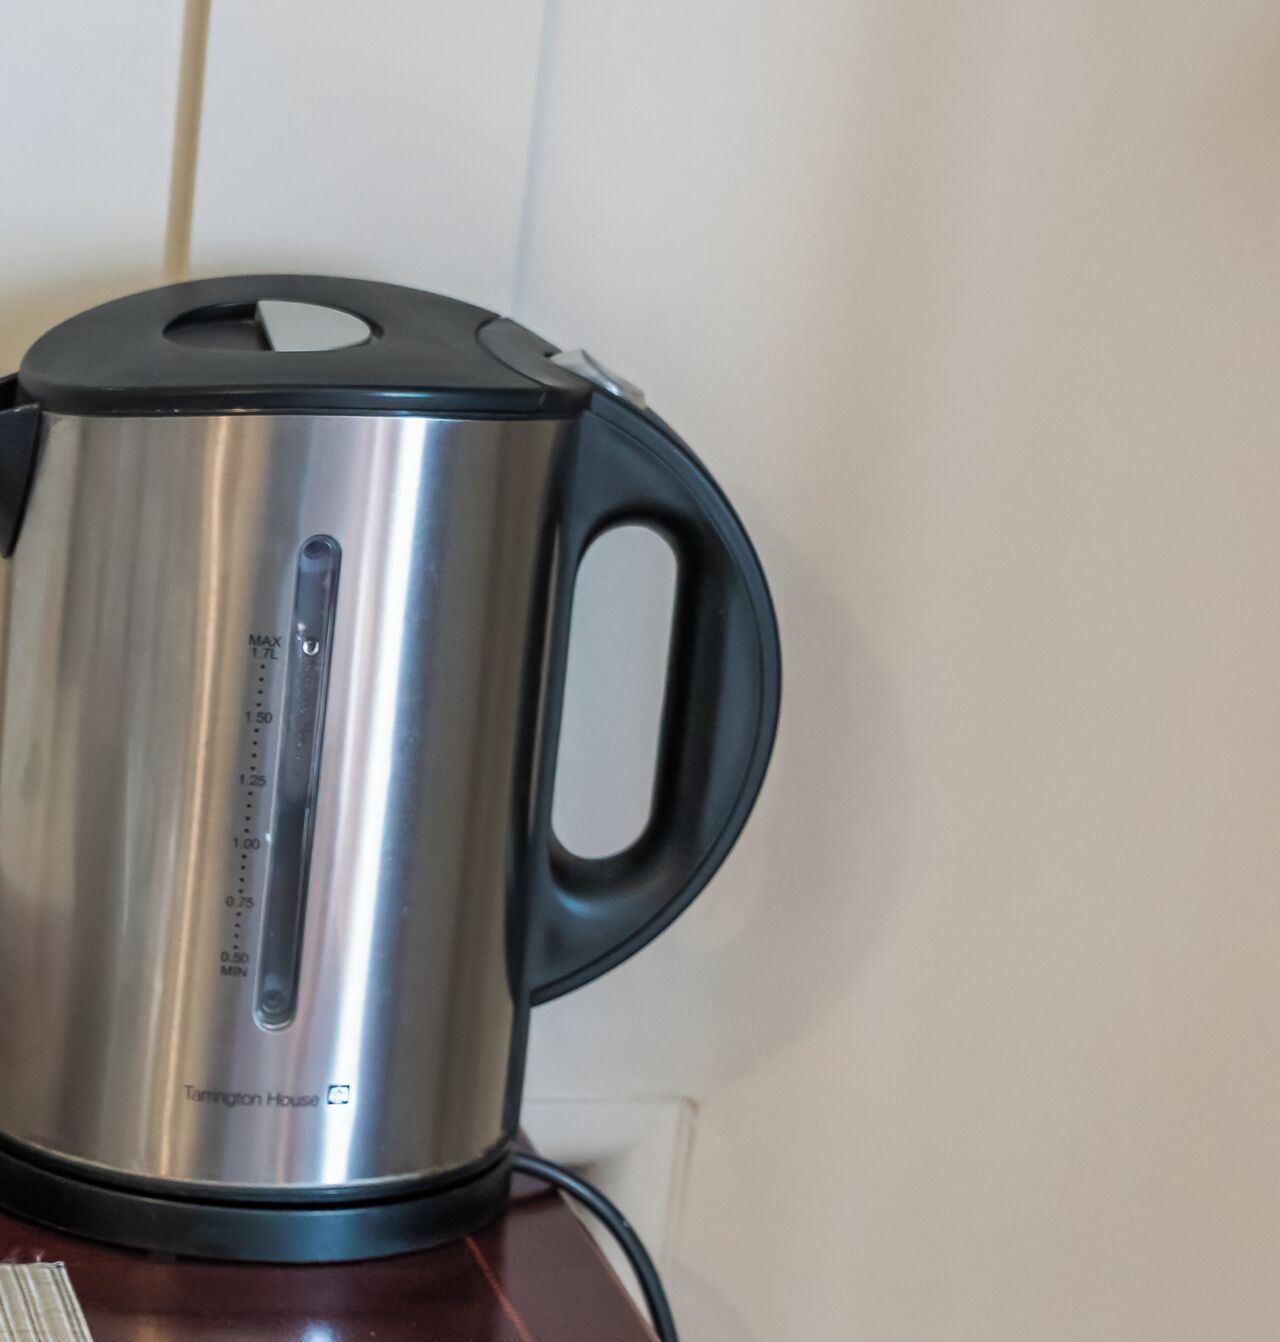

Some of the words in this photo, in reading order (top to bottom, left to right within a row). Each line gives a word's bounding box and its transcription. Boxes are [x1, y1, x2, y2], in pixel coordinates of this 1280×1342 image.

[248, 634, 282, 648] MAX
[252, 646, 279, 660] 1.7L
[244, 711, 273, 724] 1.50
[239, 774, 267, 787] 1.25
[233, 838, 261, 850] 1.00
[225, 895, 255, 909] 0.75
[220, 951, 250, 963] 0.50
[220, 965, 248, 978] MIN
[266, 1091, 320, 1107] House
